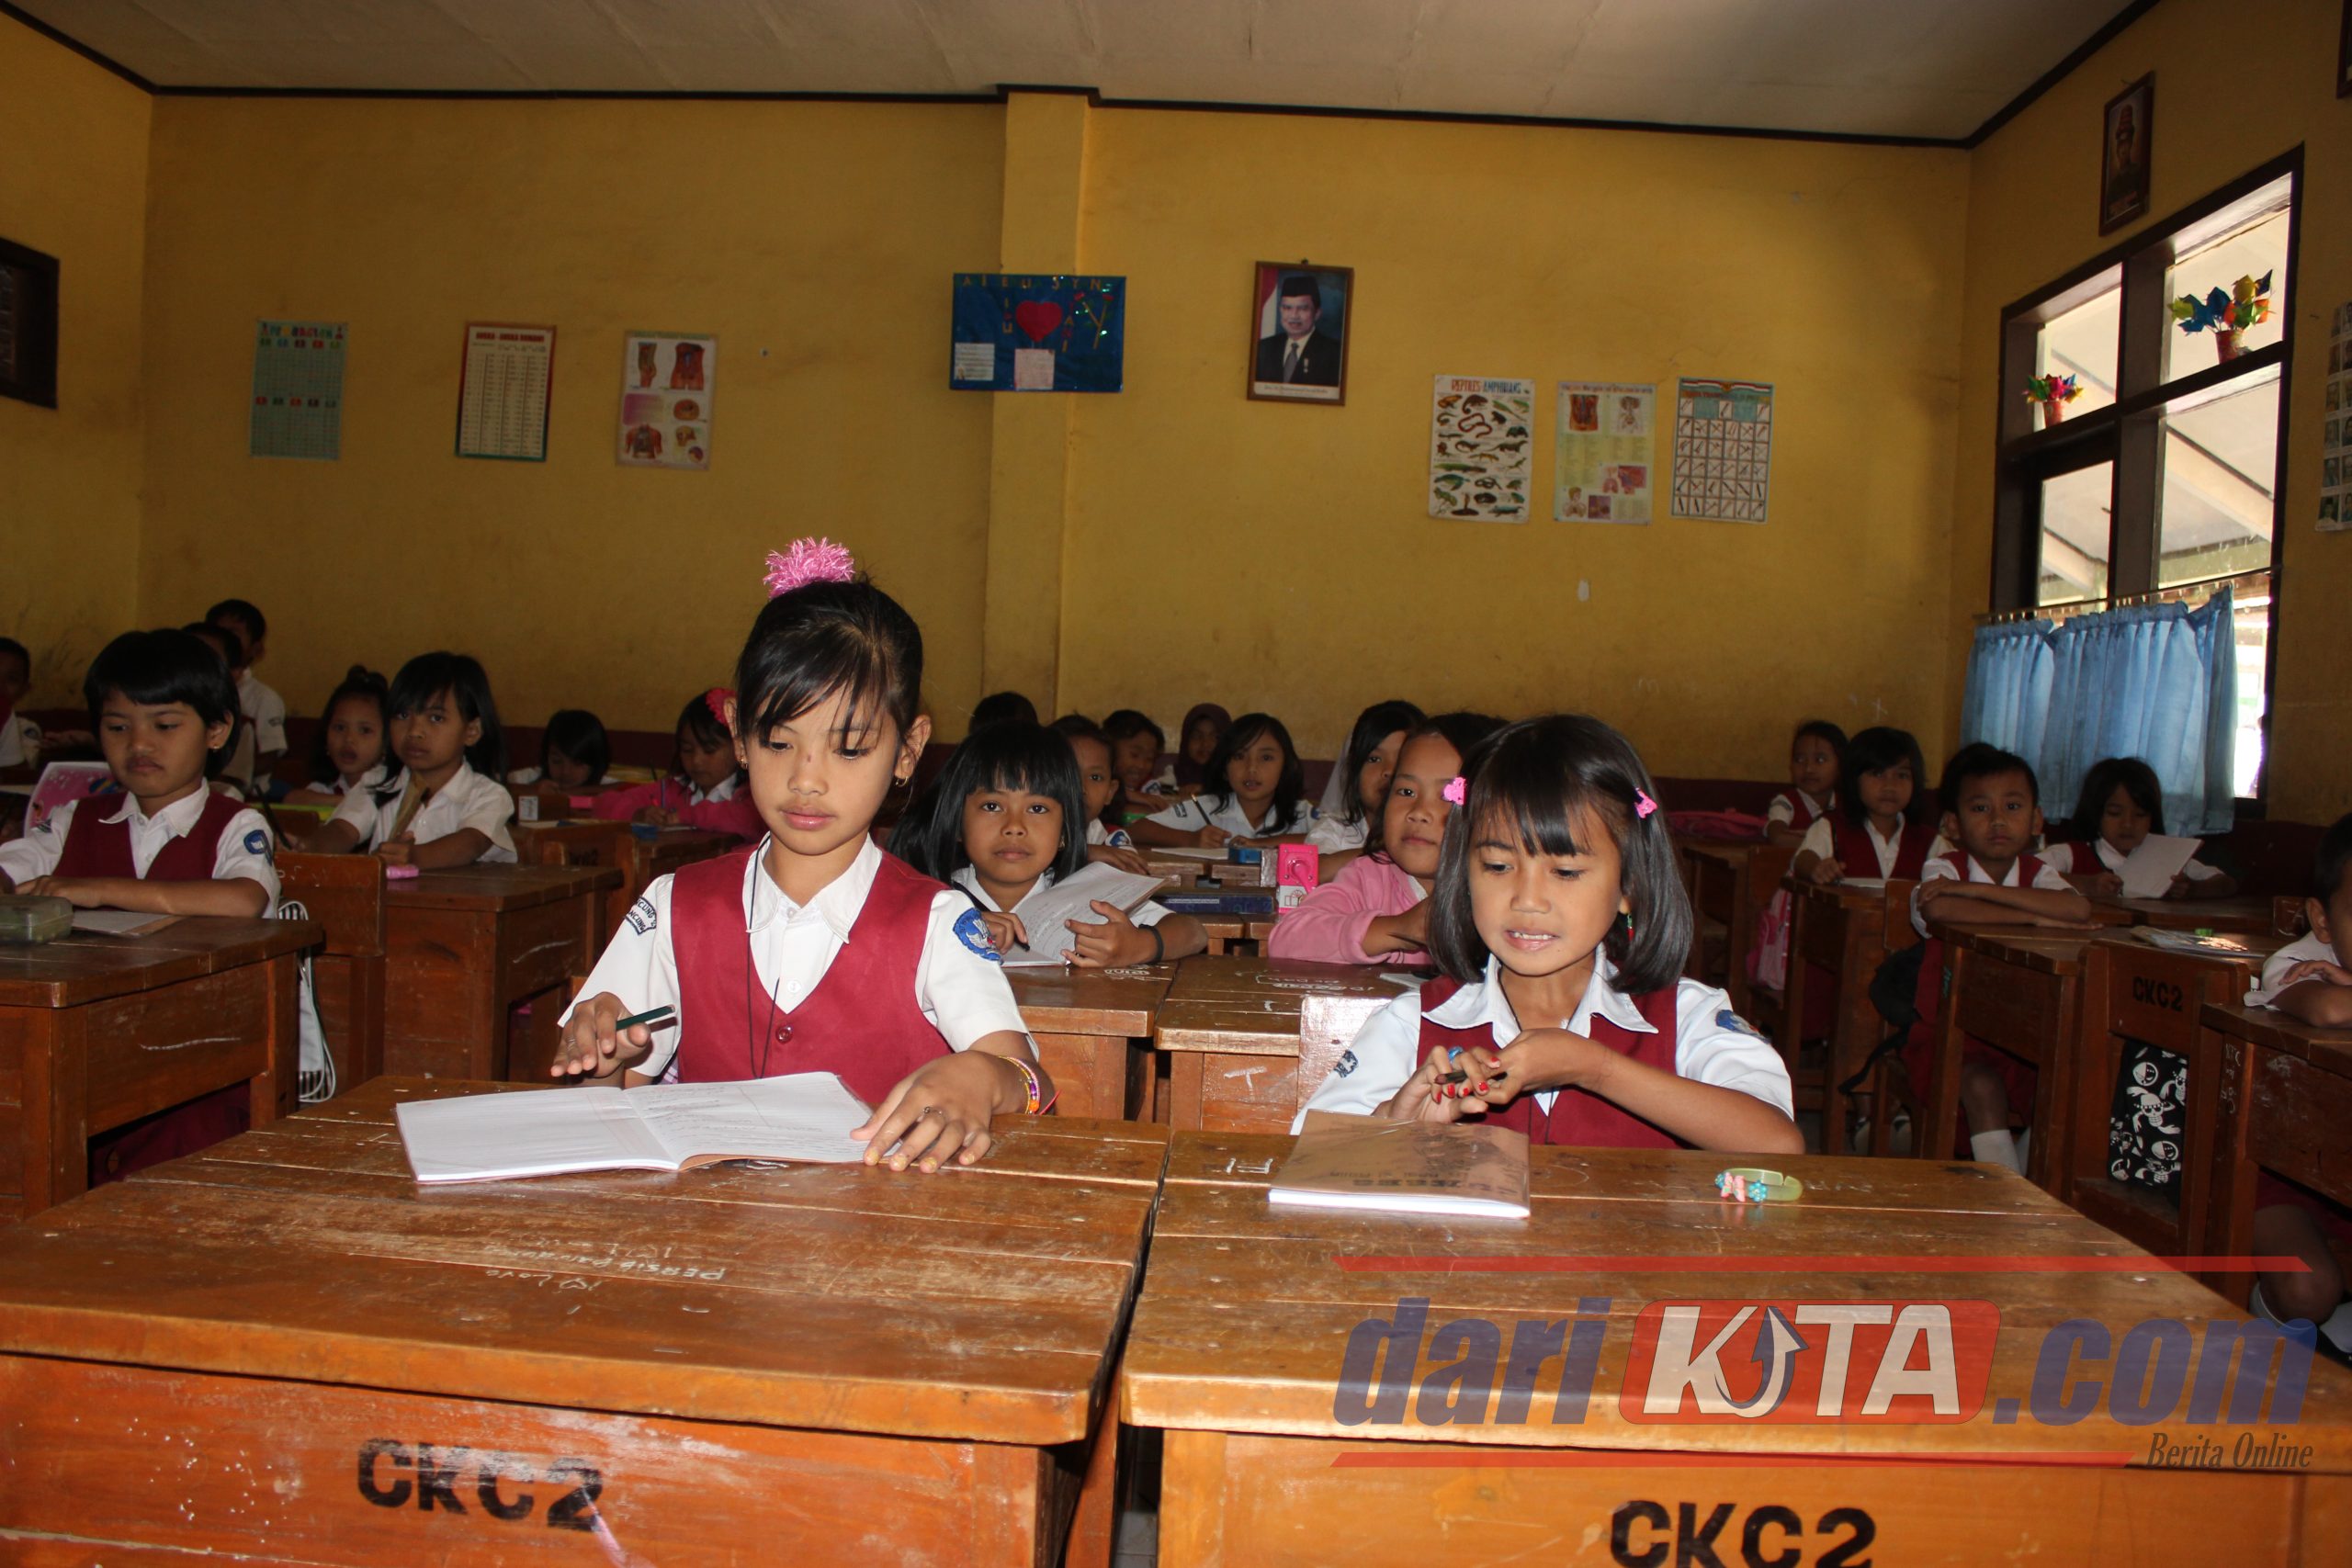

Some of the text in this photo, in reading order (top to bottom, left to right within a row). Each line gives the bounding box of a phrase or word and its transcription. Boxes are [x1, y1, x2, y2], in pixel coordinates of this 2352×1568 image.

[1451, 378, 1521, 393] REPTILES AMPHIBIANS
[2132, 976, 2184, 1011] CKC2
[356, 1437, 604, 1533] CKC2
[1610, 1500, 1876, 1568] CKC2
